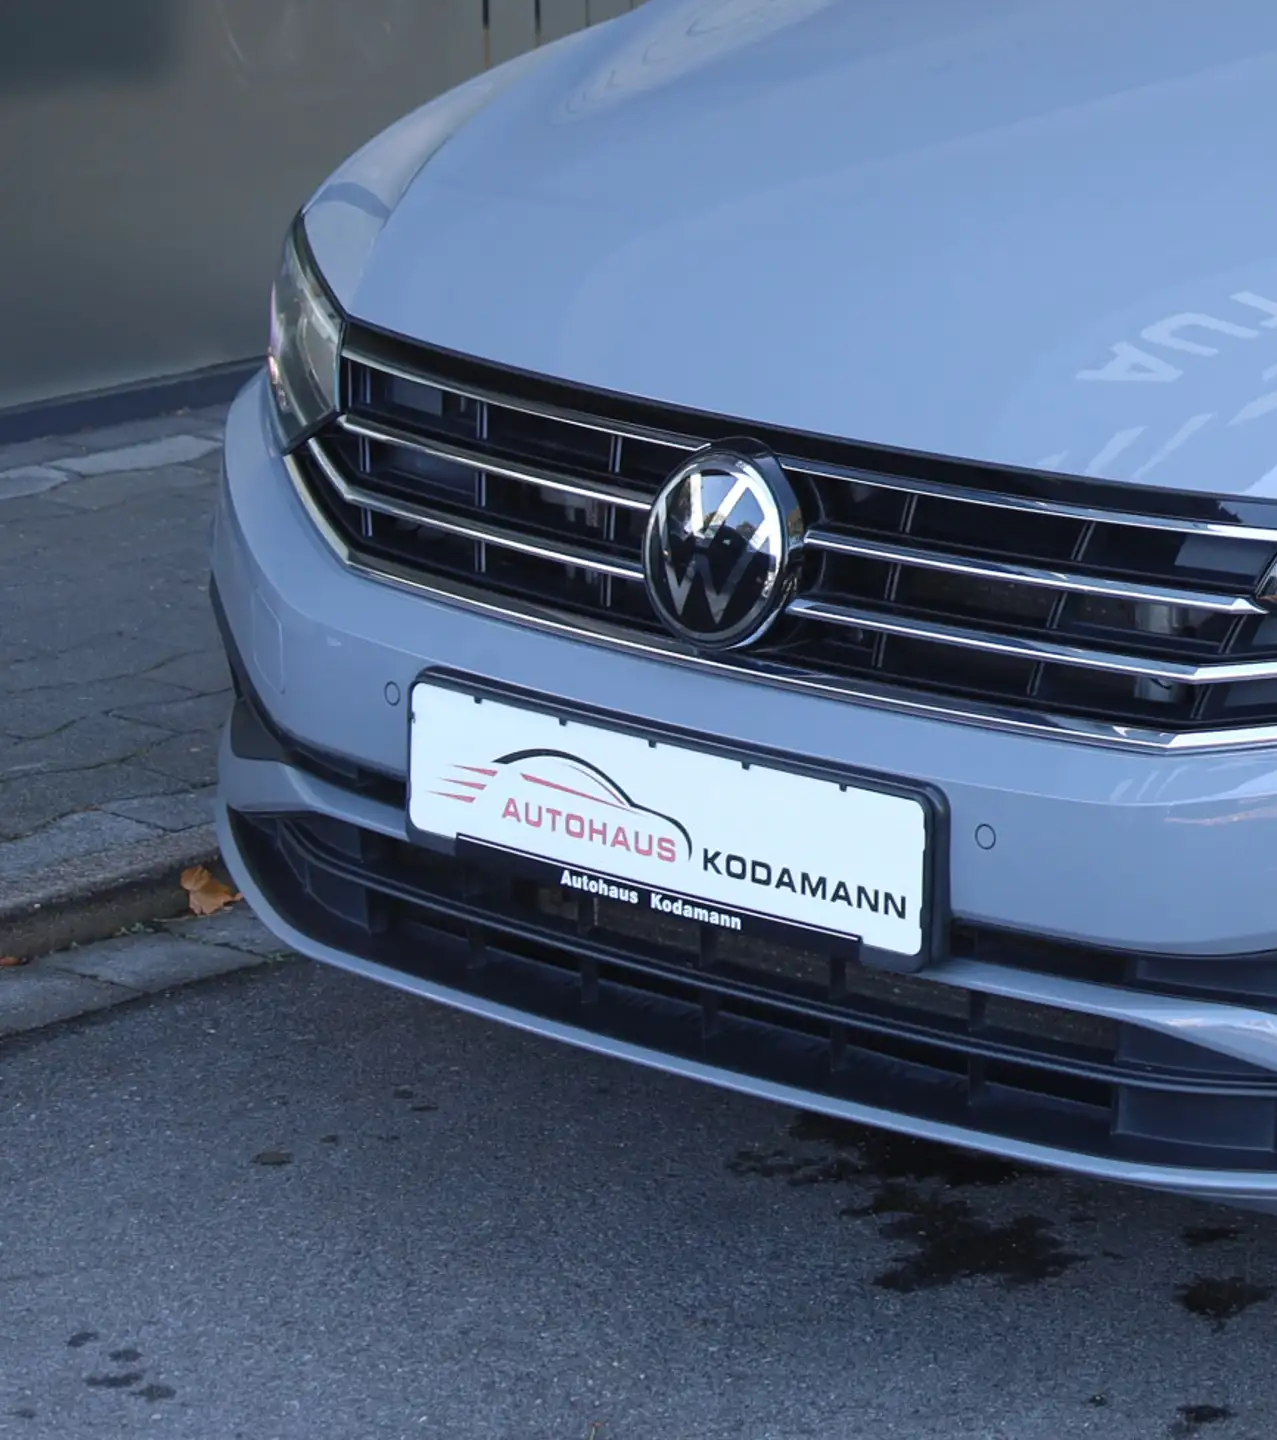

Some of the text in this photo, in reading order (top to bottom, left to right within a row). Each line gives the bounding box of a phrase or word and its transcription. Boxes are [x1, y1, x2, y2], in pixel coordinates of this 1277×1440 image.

[502, 797, 908, 920] AUTOHAUS KODAMANN
[560, 869, 742, 931] Autohaus Kodamann
